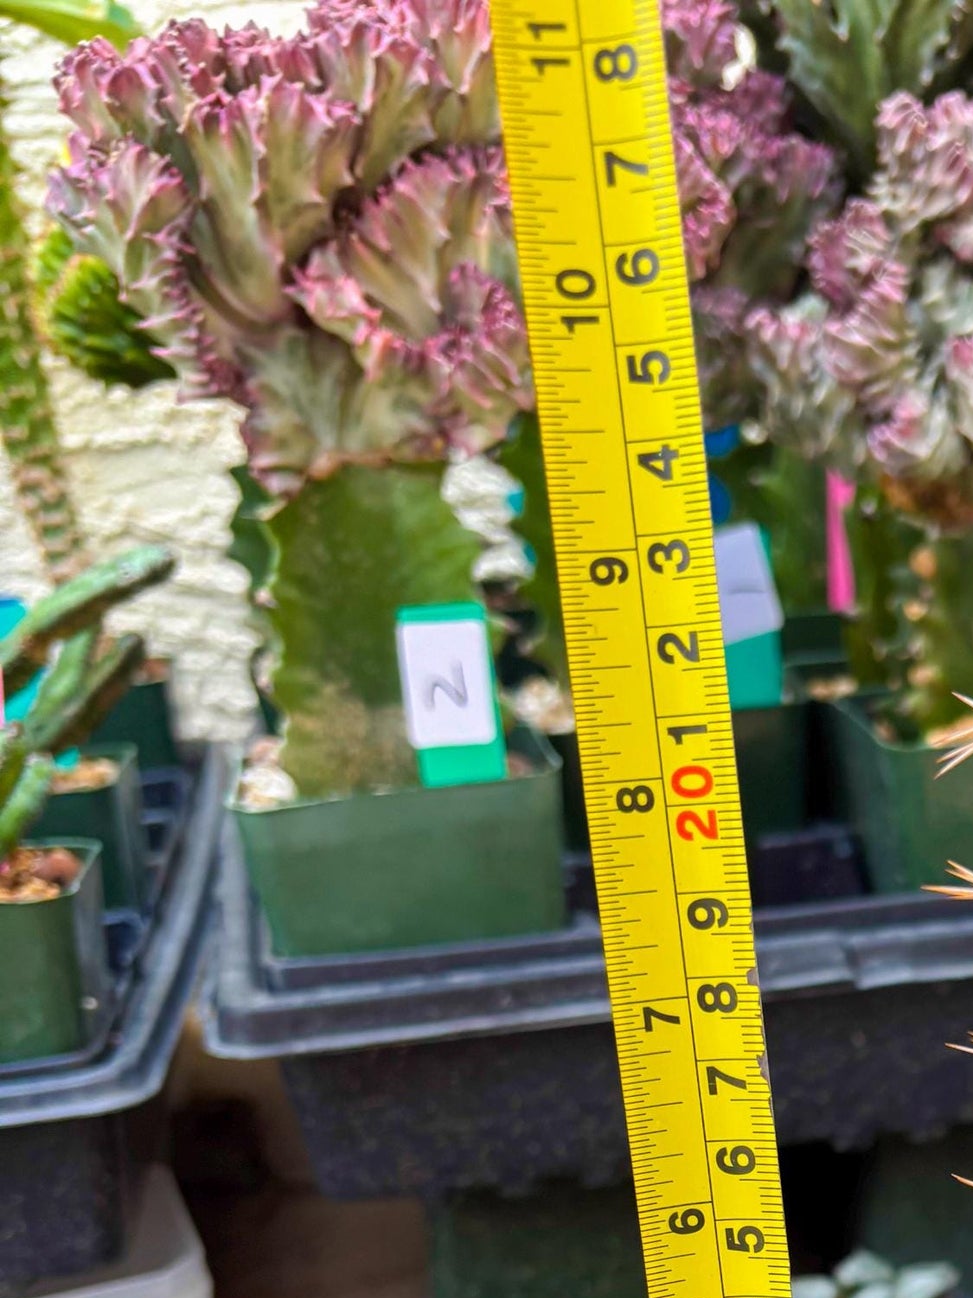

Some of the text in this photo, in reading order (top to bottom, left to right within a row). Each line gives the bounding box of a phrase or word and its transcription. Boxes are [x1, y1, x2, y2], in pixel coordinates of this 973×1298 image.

[527, 22, 570, 76] 11
[593, 44, 639, 83] 8
[604, 151, 650, 187] 7
[615, 248, 661, 288] 6
[555, 268, 600, 334] 10
[627, 350, 672, 385] 5
[637, 444, 680, 481] 4
[589, 557, 629, 587] 9
[647, 539, 691, 575] 3
[657, 631, 700, 665] 2
[667, 724, 707, 745] 1
[616, 784, 656, 815] 8
[671, 765, 719, 841] 20
[687, 898, 729, 930] 9
[696, 982, 739, 1014] 8
[643, 1006, 680, 1032] 7
[705, 1066, 748, 1096] 7
[715, 1145, 757, 1175] 6
[668, 1208, 706, 1235] 6
[726, 1225, 765, 1254] 5
